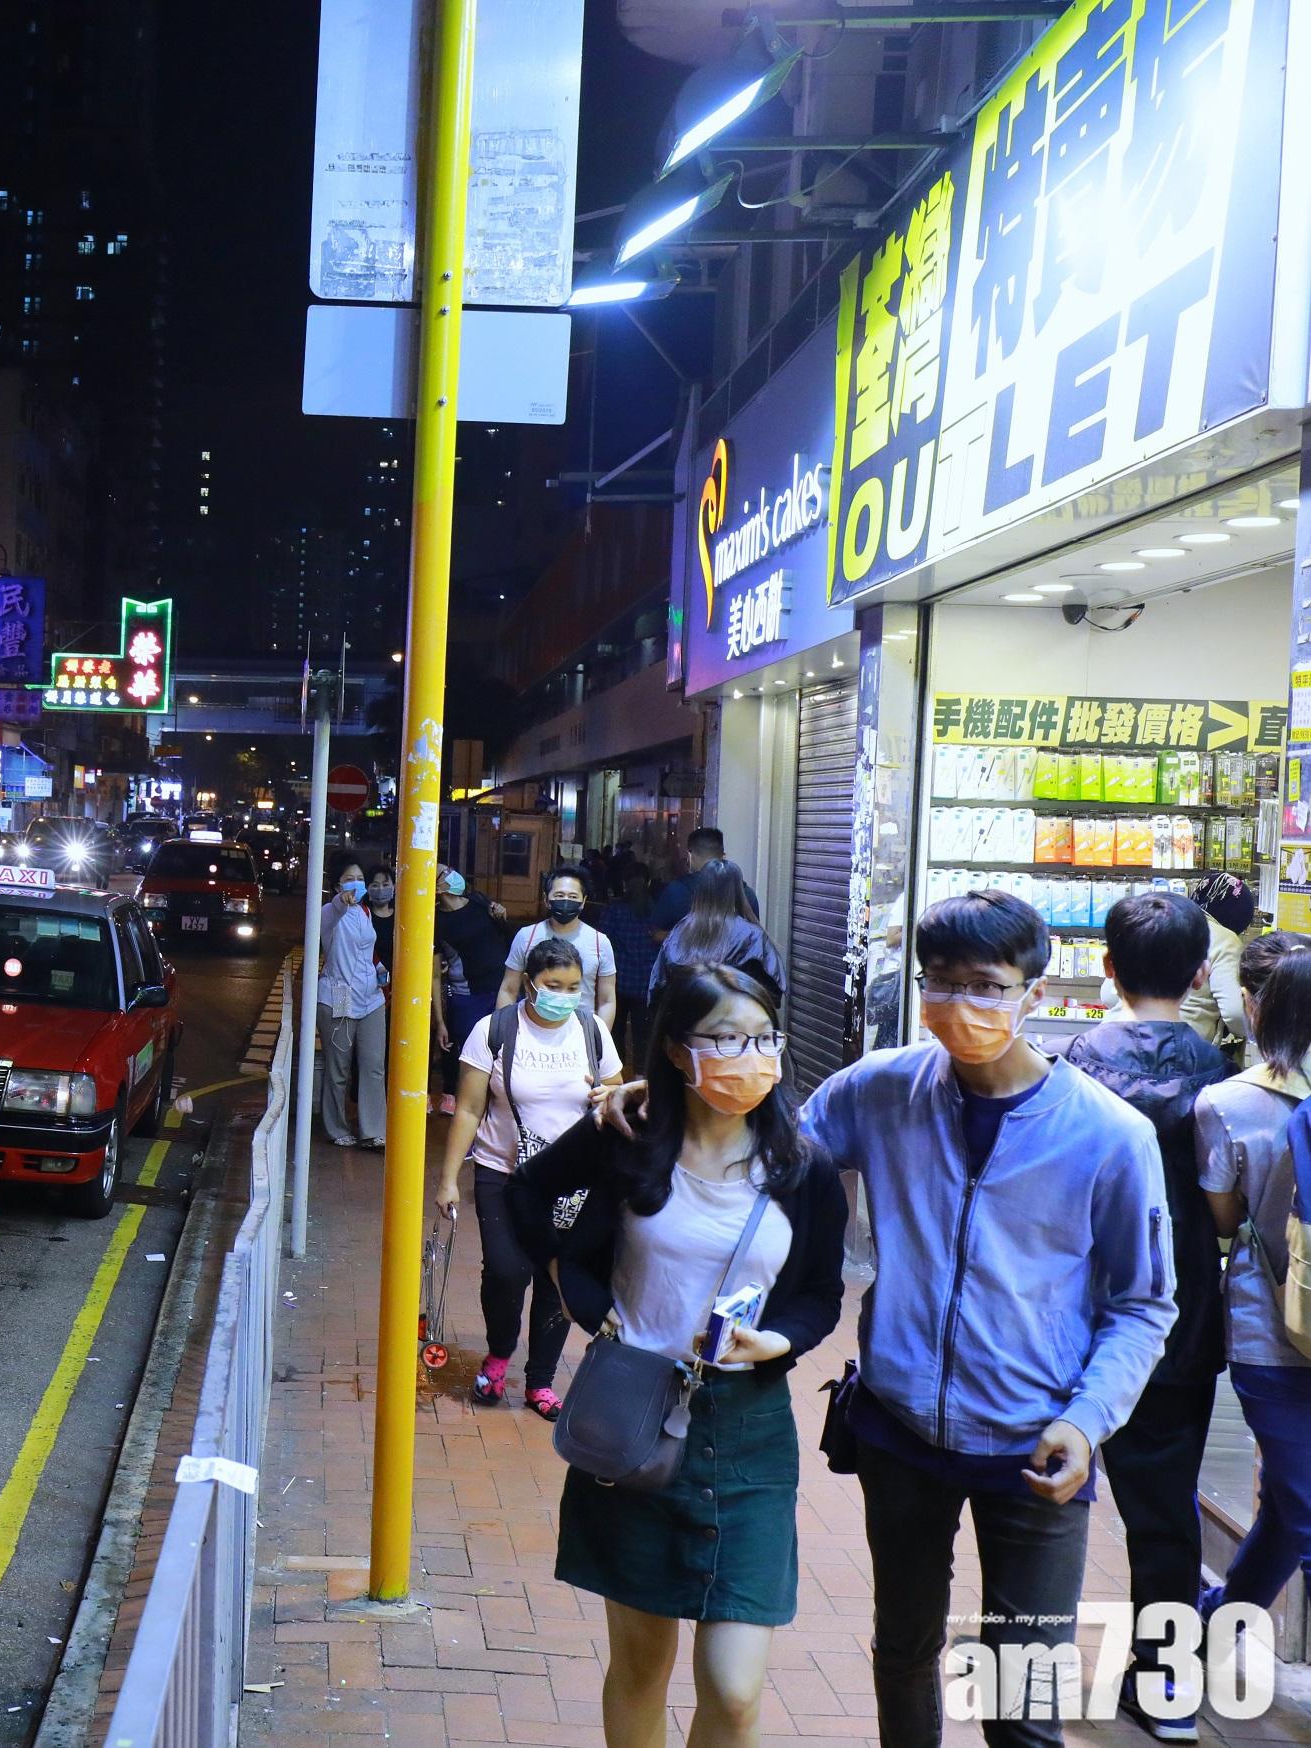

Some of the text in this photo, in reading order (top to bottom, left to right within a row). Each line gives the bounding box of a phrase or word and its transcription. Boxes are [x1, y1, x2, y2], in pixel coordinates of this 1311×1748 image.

[842, 246, 1215, 583] OUTLET
[714, 453, 823, 588] maxim's cakes
[726, 568, 784, 660] 美心西餅
[1048, 1007, 1066, 1017] $25
[1086, 1009, 1104, 1019] $25
